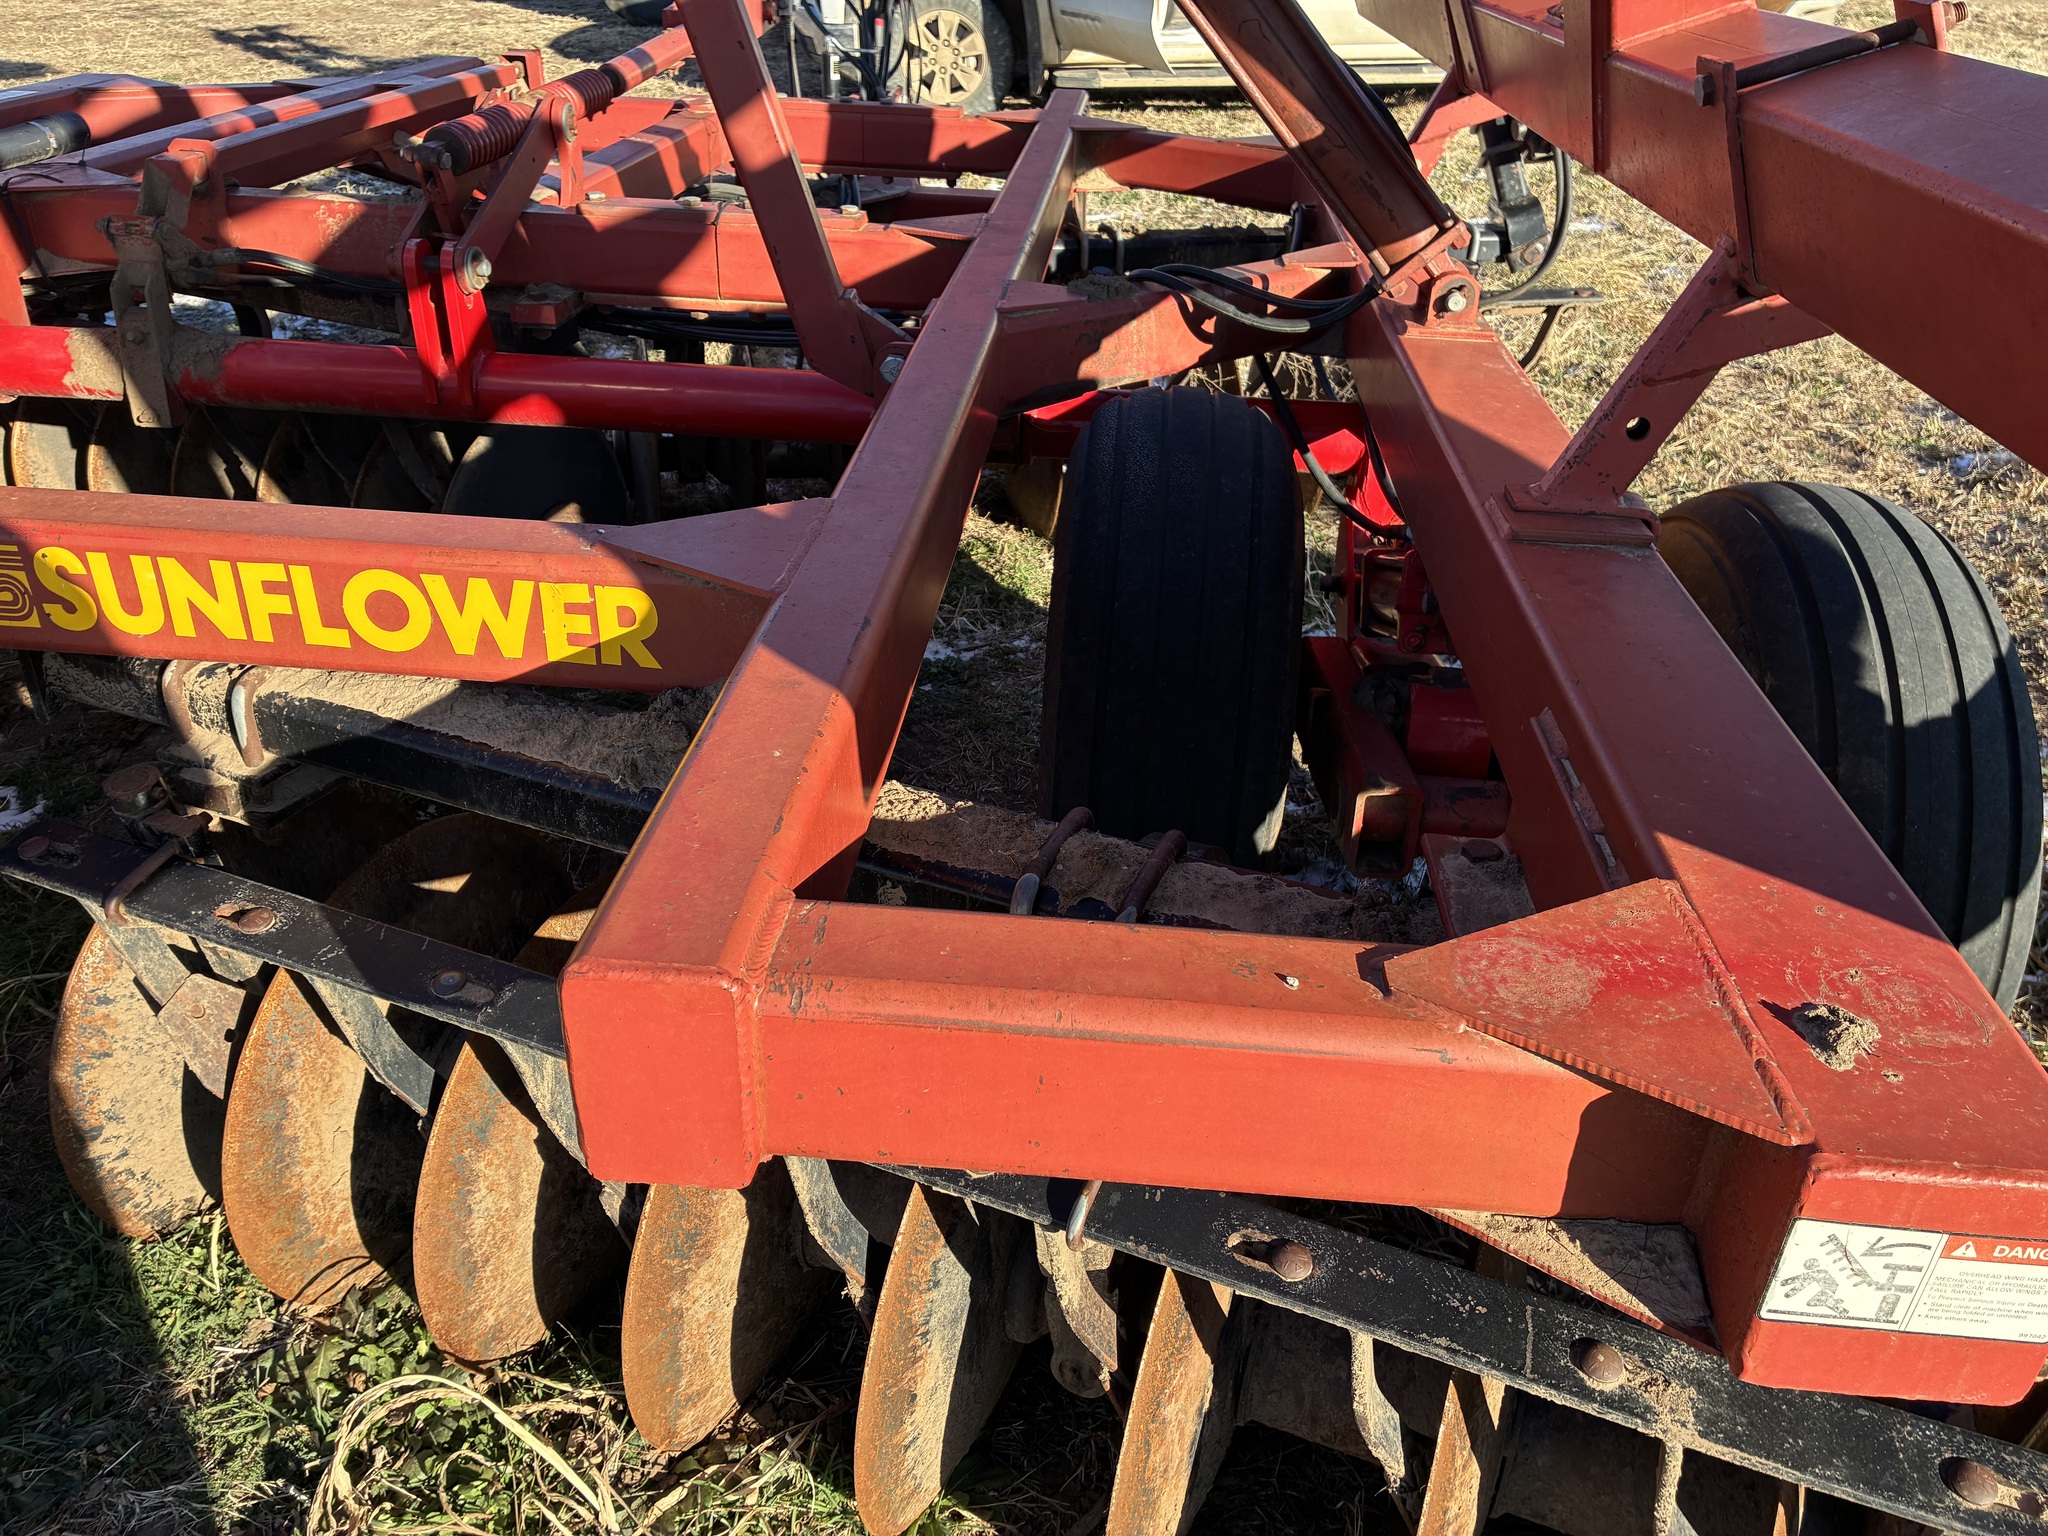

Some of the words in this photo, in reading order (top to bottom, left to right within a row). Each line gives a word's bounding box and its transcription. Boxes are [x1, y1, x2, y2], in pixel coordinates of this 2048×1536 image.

[34, 546, 662, 670] SUNFLOWER
[1959, 1271, 2002, 1280] OVERHEAD
[1934, 1276, 1986, 1286] MECHANICAL
[2001, 1282, 2046, 1291] HYDRAULIC
[1951, 1288, 1984, 1296] RAPIDLY
[2015, 1288, 2042, 1296] WINGS
[1937, 1294, 1966, 1302] Prevent
[1930, 1301, 1953, 1309] Stand
